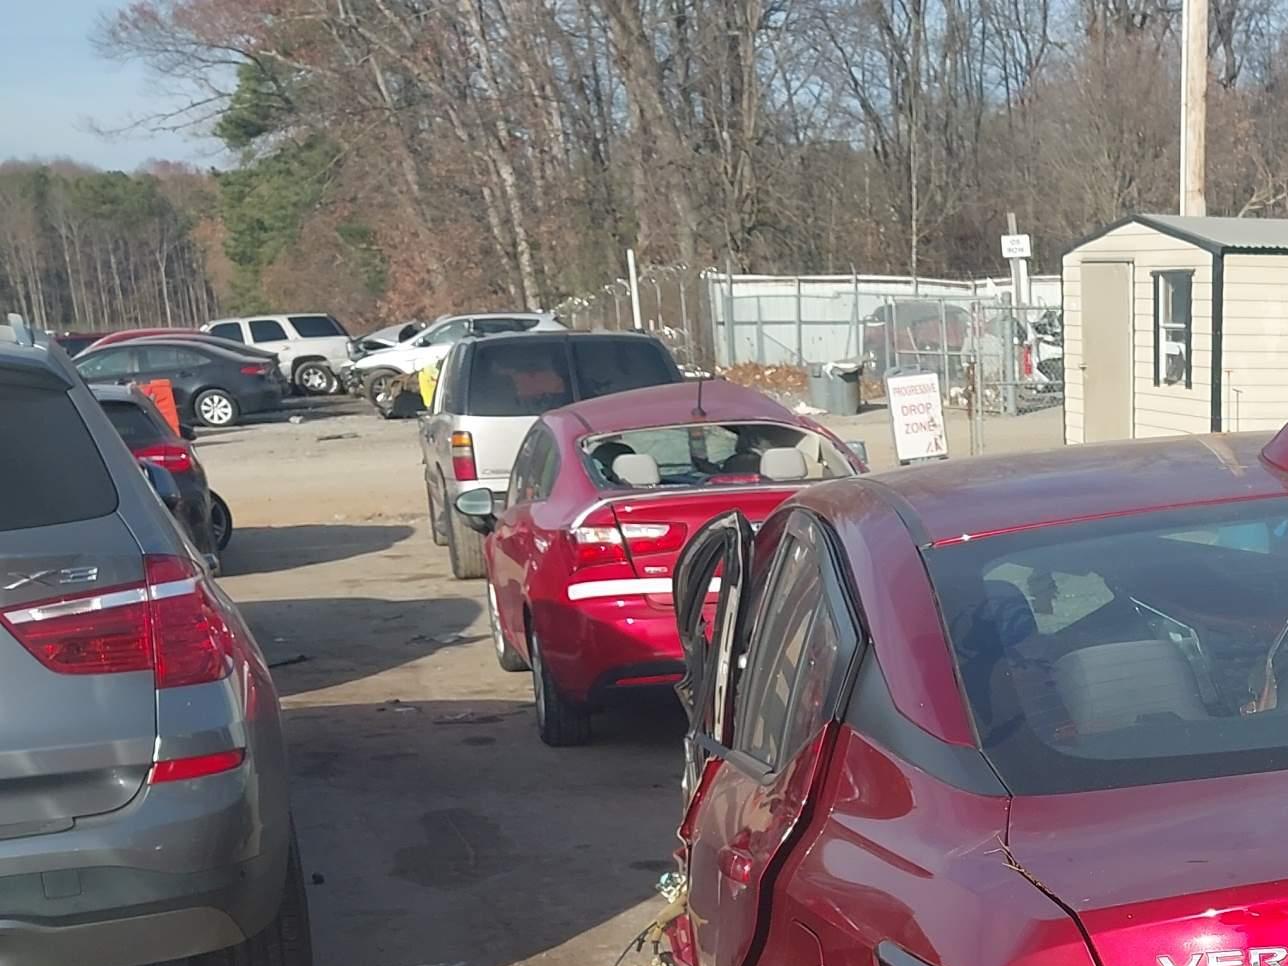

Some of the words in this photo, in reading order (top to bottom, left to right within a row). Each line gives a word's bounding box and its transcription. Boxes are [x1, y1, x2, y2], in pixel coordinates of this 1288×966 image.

[901, 402, 932, 417] DROP
[904, 419, 935, 435] ZONE
[2, 566, 98, 590] X3
